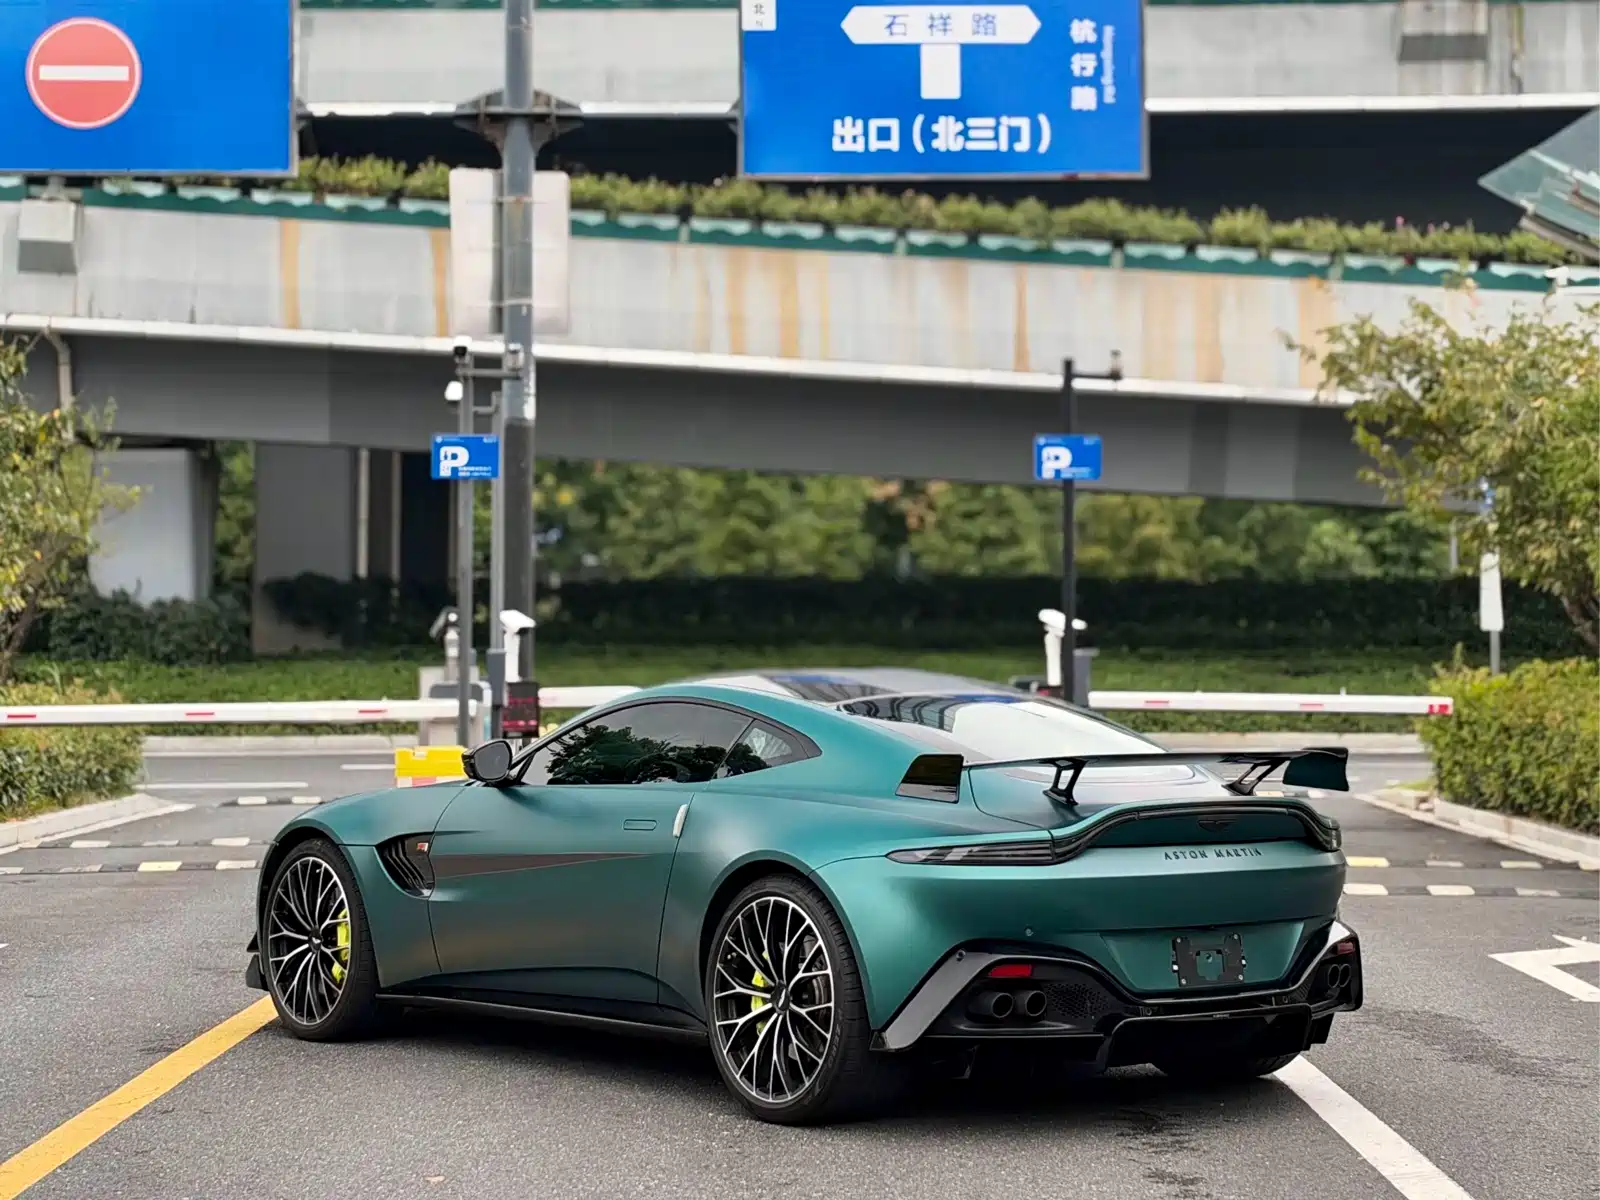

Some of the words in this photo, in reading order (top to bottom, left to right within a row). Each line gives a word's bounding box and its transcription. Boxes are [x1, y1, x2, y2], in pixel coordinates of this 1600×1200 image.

[884, 12, 997, 36] 石祥路
[832, 113, 1051, 154] 出口（北三门）
[439, 446, 469, 477] P
[1041, 446, 1072, 480] P
[1164, 849, 1208, 861] ASTON
[1213, 847, 1262, 858] MARTIN
